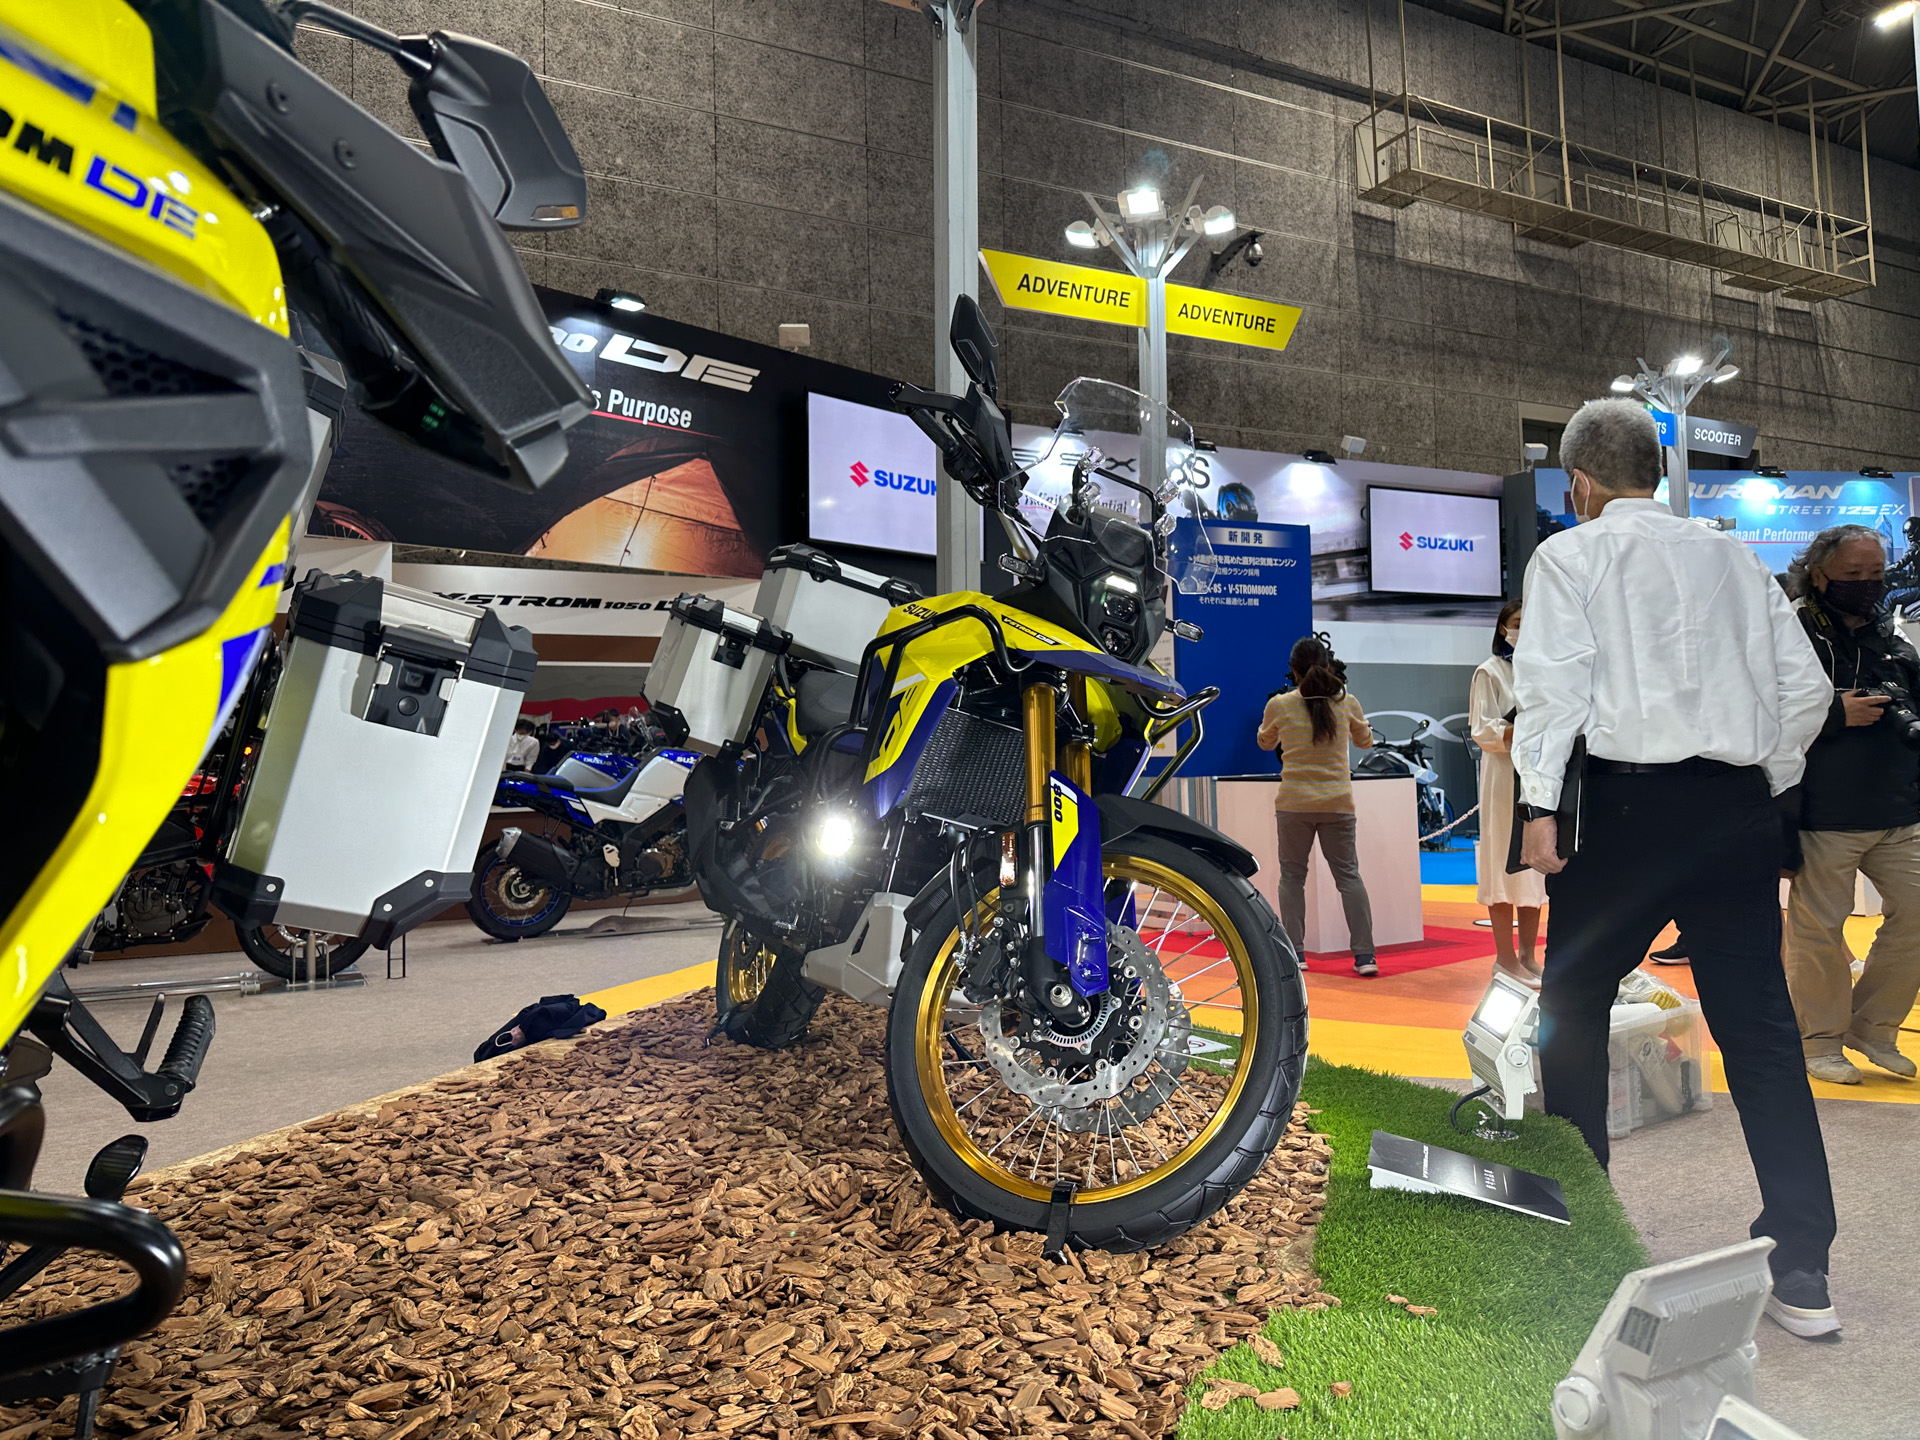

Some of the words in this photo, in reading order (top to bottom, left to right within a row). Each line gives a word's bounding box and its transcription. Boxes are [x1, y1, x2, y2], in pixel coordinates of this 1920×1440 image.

[1017, 272, 1132, 308] ADVENTURE
[1178, 302, 1277, 334] ADVENTURE
[599, 333, 761, 393] DE
[607, 388, 692, 429] Purpose
[1694, 427, 1742, 446] SCOOTER
[1879, 503, 1906, 516] EX
[1228, 530, 1263, 545] 新開発
[1416, 536, 1474, 552] SUZUKI
[603, 601, 652, 611] 1050
[1053, 783, 1063, 823] 800
